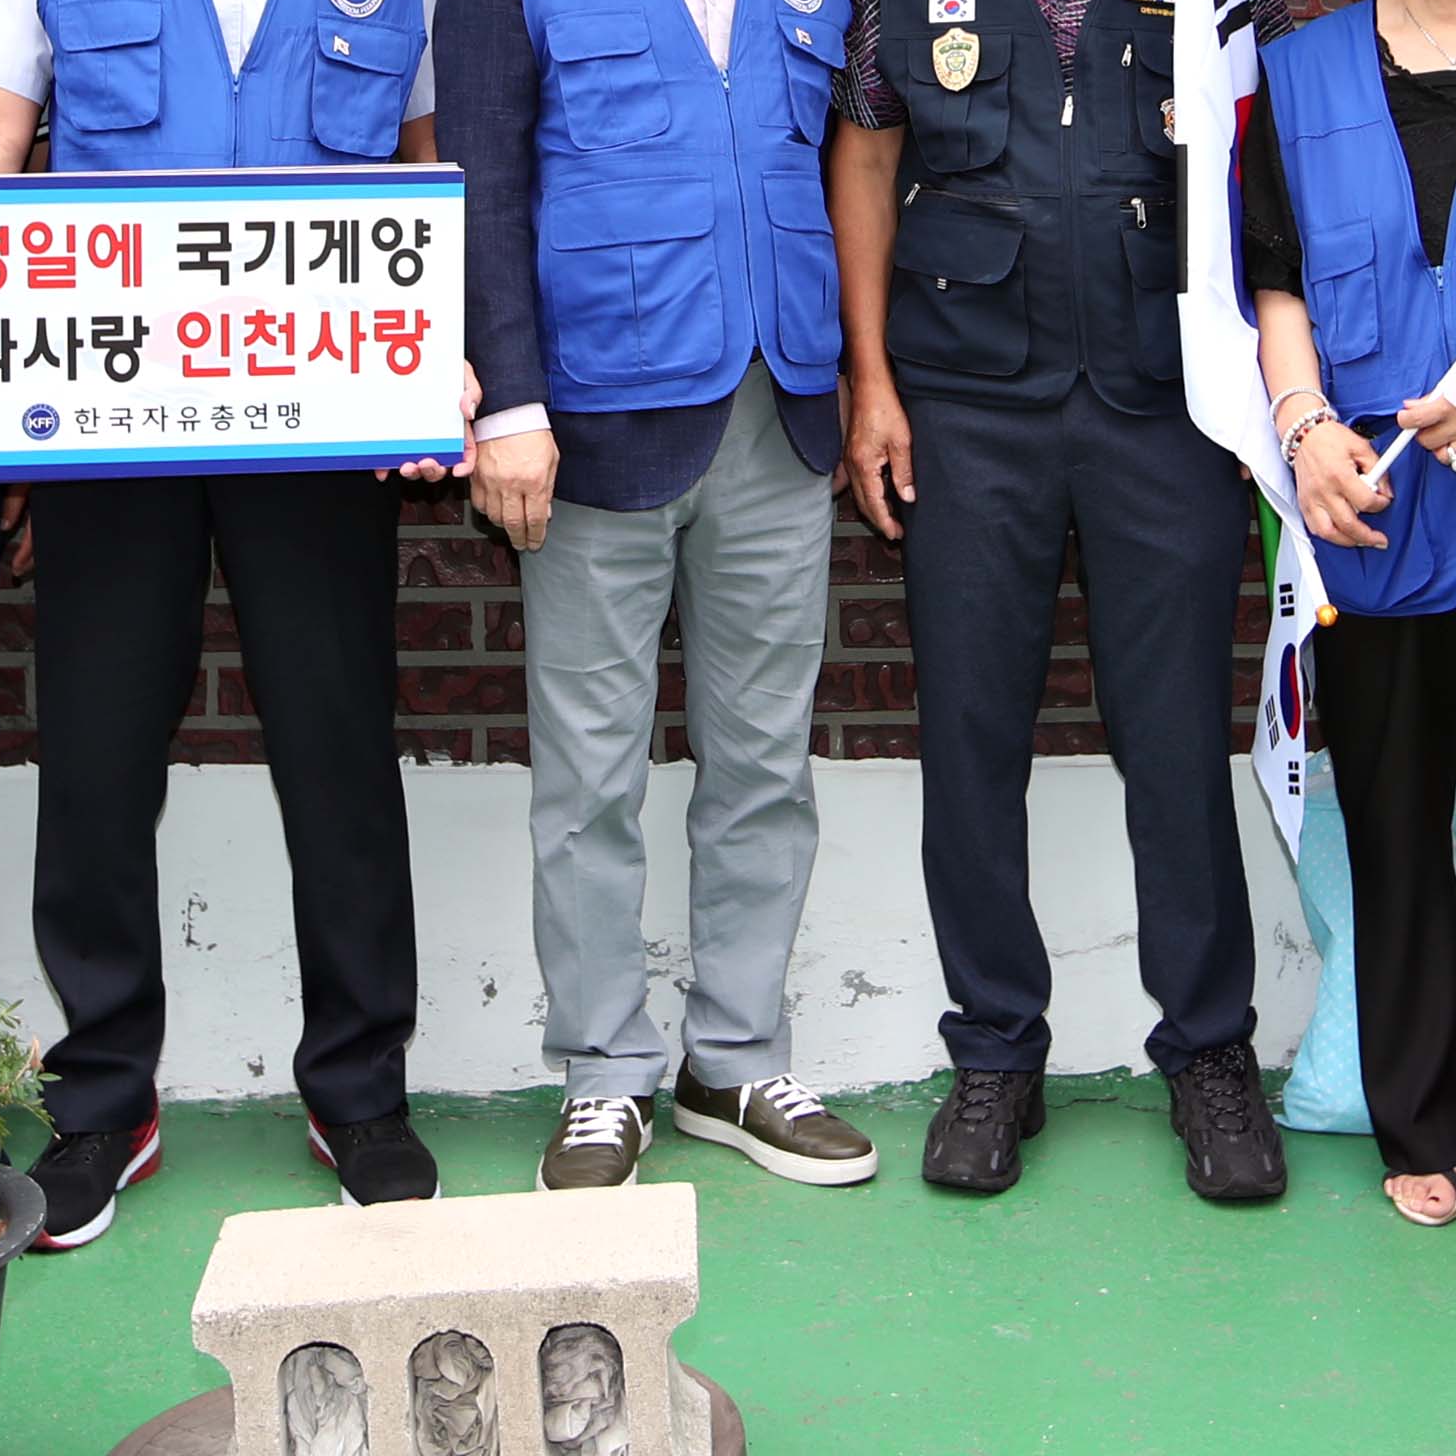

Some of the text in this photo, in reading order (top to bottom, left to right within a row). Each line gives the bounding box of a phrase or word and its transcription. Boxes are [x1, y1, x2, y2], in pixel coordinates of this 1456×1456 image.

[176, 217, 432, 287] 국기게양
[176, 309, 432, 378] 인천사랑
[28, 416, 55, 429] KFF
[74, 401, 302, 435] 한국자유총연맹
